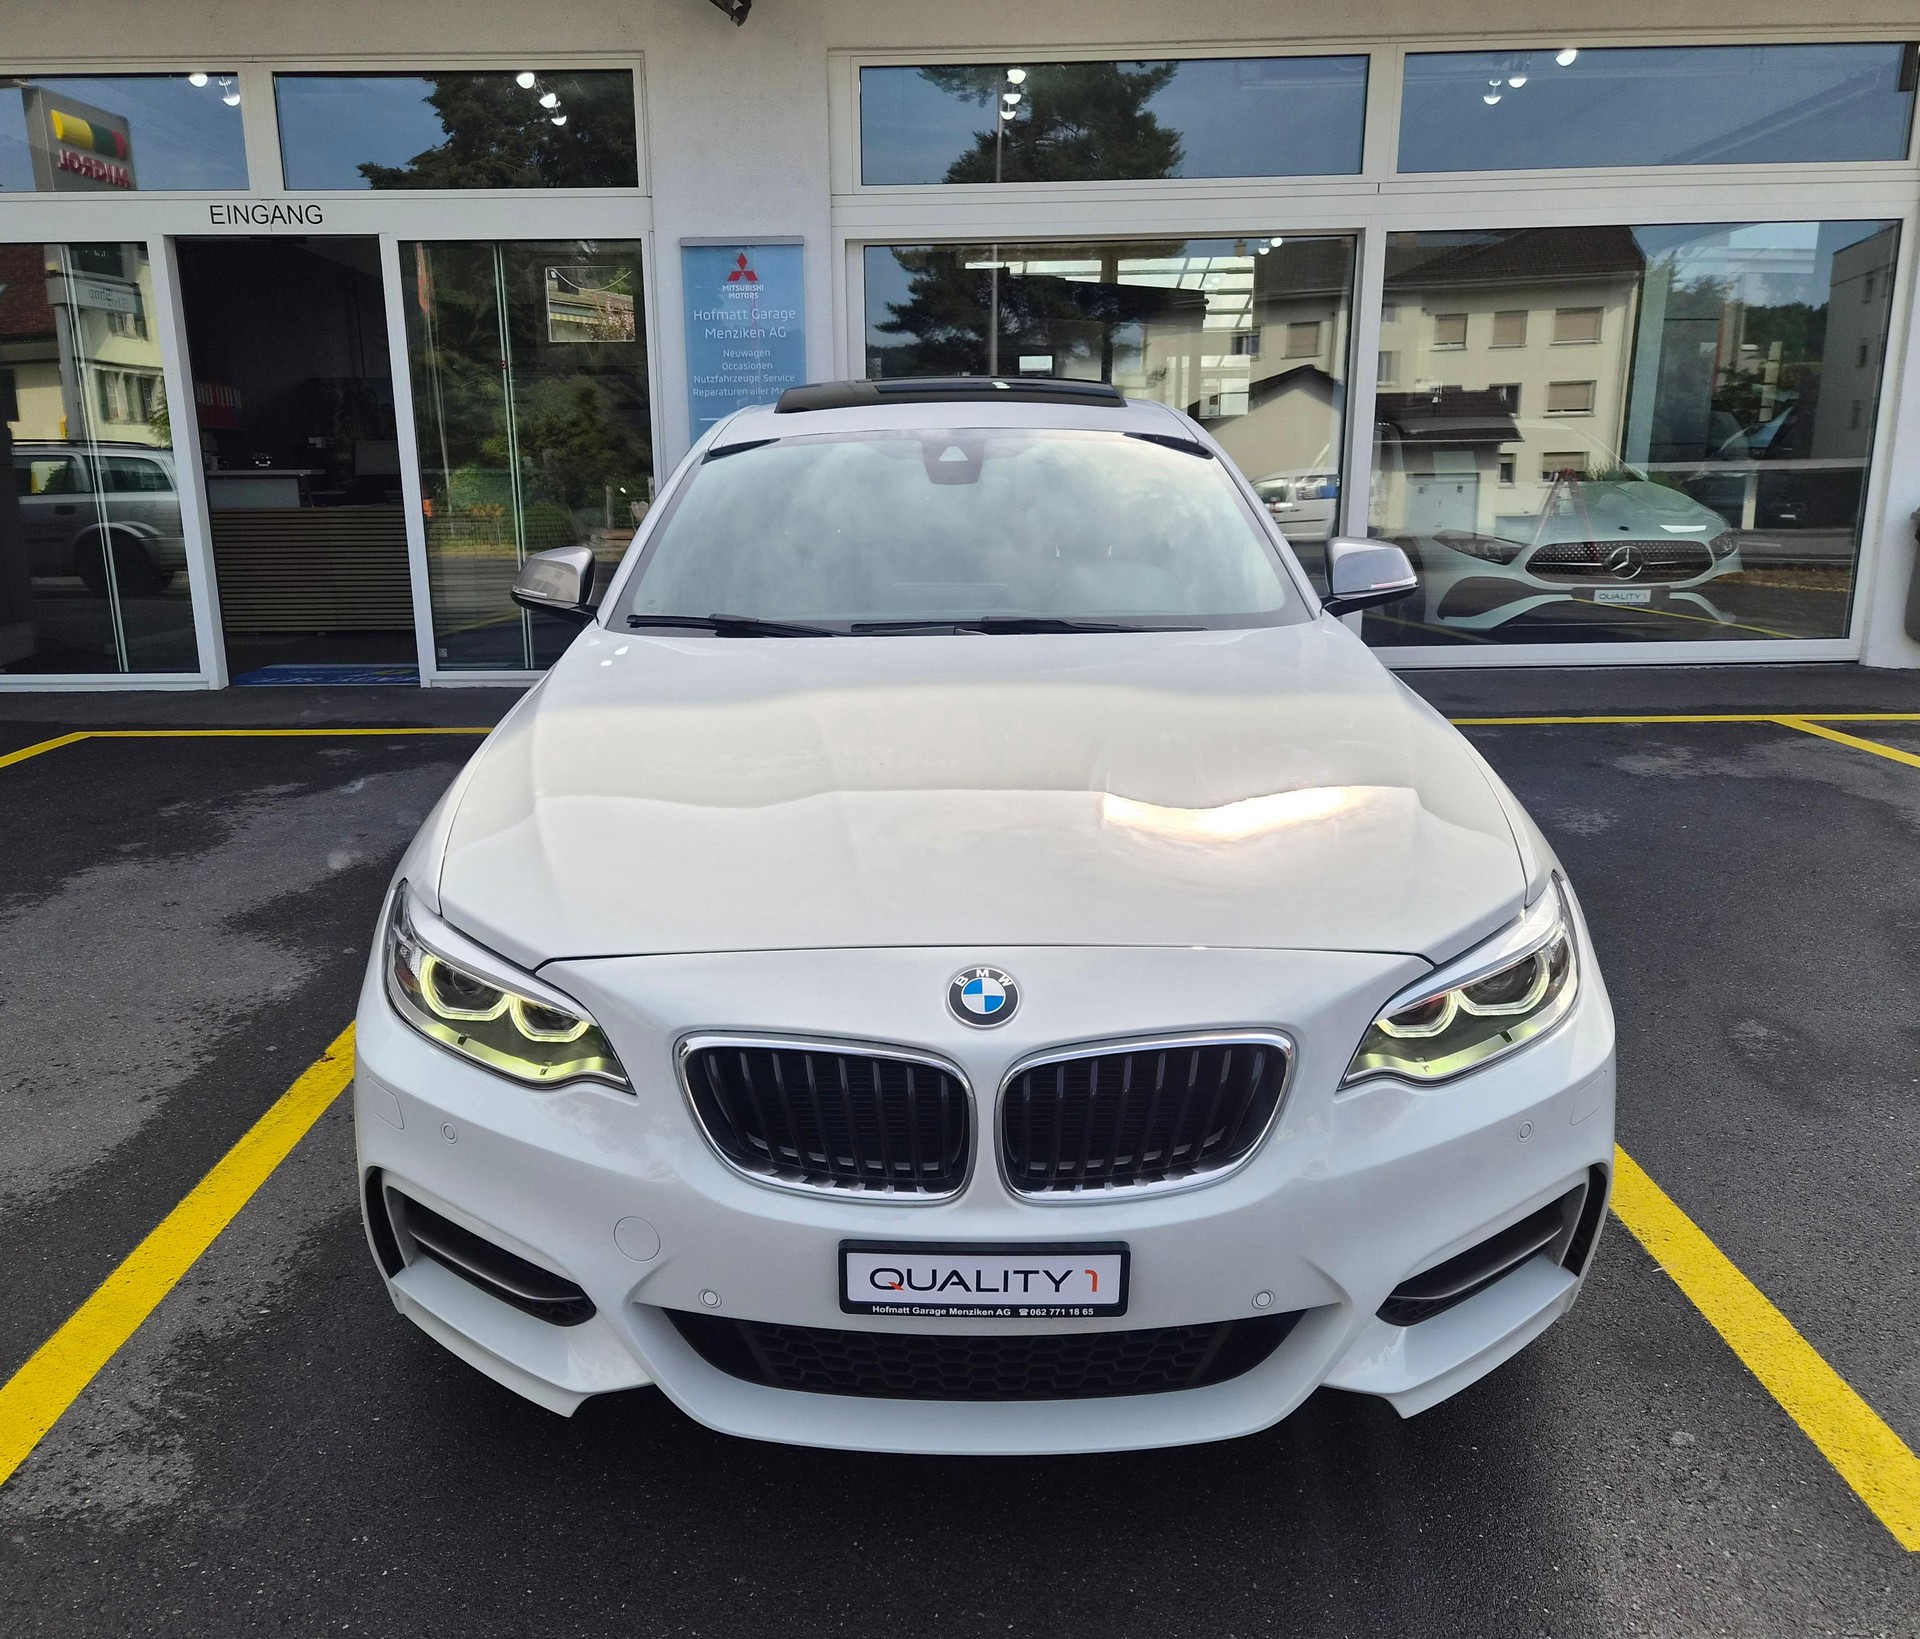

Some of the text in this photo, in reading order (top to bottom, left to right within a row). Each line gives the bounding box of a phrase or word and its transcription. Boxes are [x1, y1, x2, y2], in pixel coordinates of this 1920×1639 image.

[209, 204, 323, 225] EINGANG
[722, 284, 764, 292] MITSUBISHI
[728, 292, 759, 300] MOTORS
[693, 308, 796, 322] Hofmatt Garage
[704, 326, 787, 339] Menziken AG
[723, 349, 771, 359] Neuwagen
[721, 362, 773, 371] Occasionen
[693, 373, 795, 385] Nutzfahrzeuge Service
[693, 387, 748, 398] Reparaturen
[750, 386, 769, 396] aller
[954, 969, 1013, 987] BMW
[869, 1267, 1099, 1293] QUALITY 1
[872, 1305, 1094, 1316] Hofmatt Garage Menziken AG 062 771 18 65
